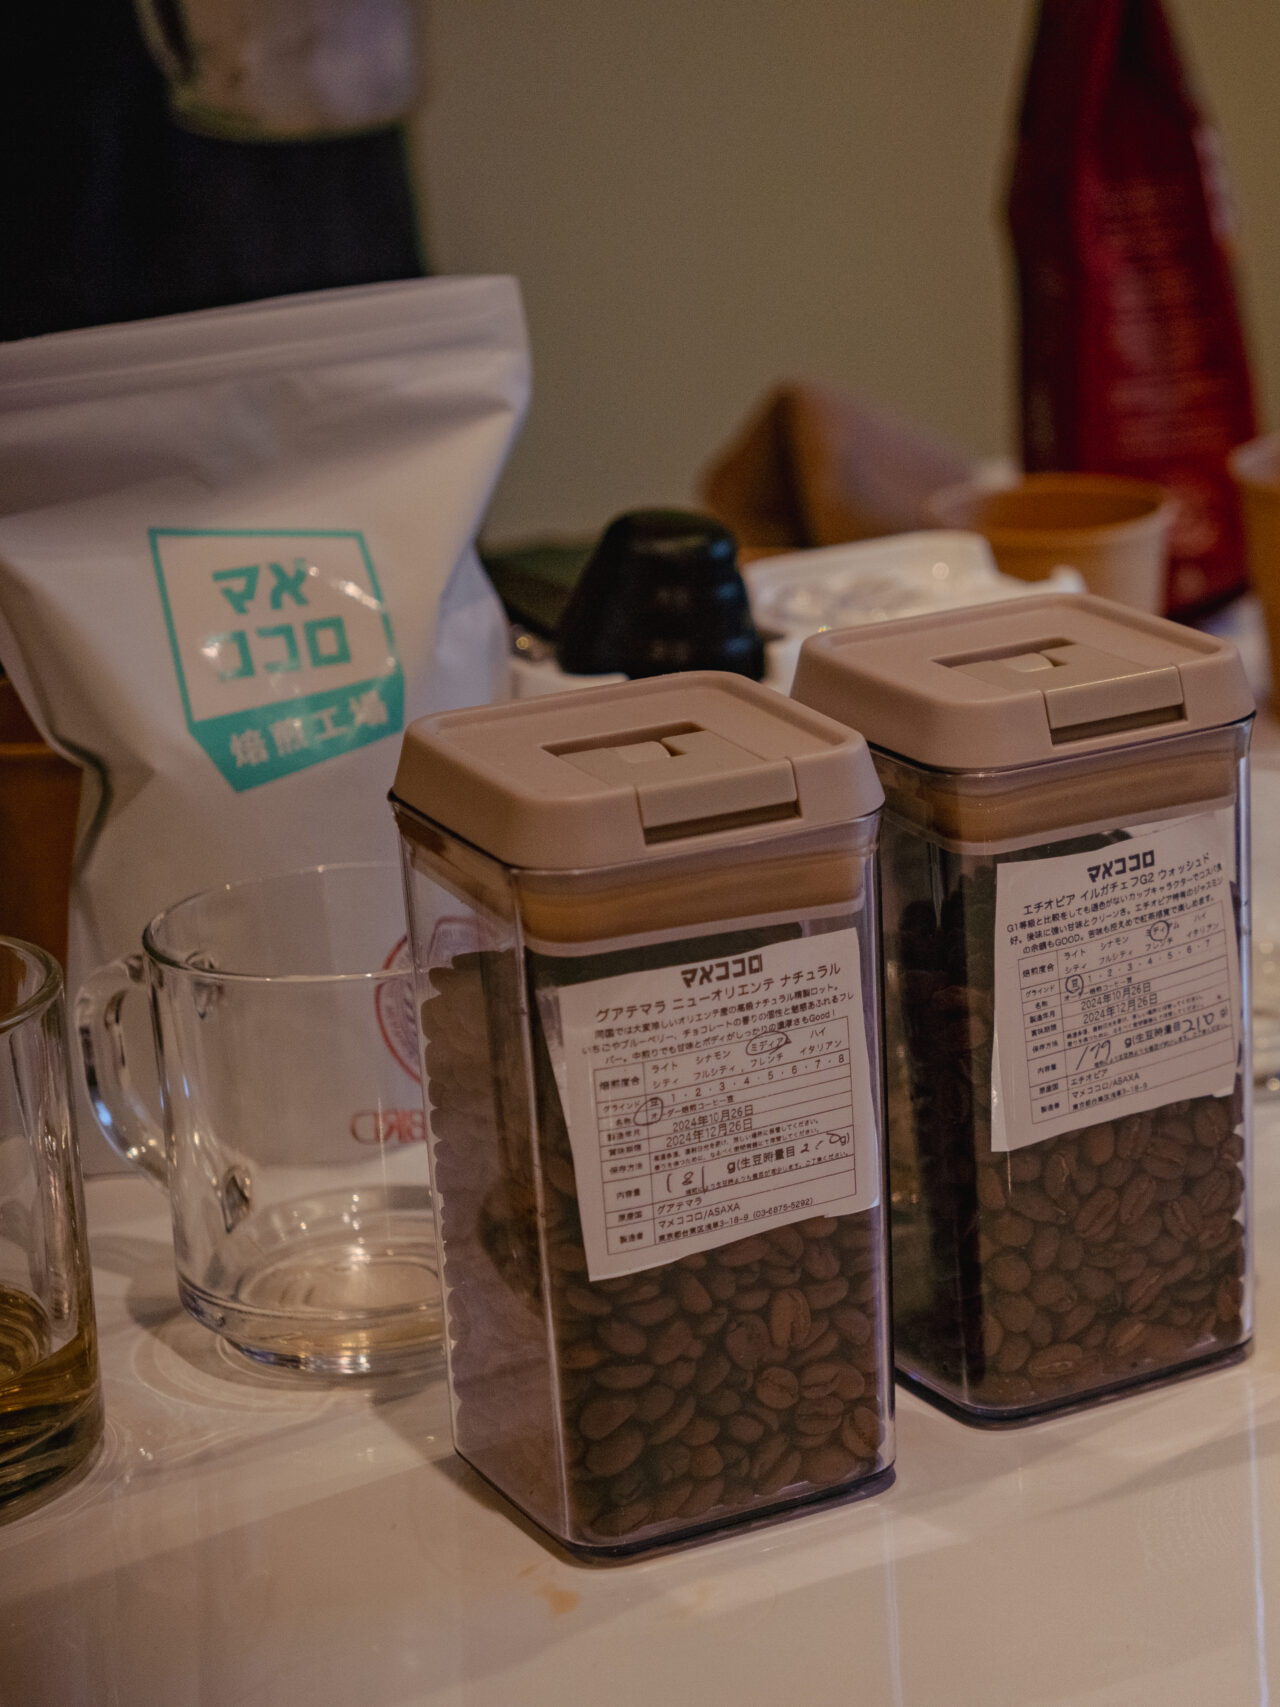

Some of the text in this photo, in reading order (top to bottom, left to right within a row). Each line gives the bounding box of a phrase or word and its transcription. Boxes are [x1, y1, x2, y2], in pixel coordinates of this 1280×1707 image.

[212, 557, 309, 614] マメ
[1087, 849, 1154, 883] マメココロ
[1023, 894, 1074, 916] エチオピア
[1081, 872, 1153, 901] イルガチェフG2
[681, 953, 763, 989] マメココロ
[595, 962, 840, 1024] グアテマラ ニューオリエンテ ナチュラル
[1081, 982, 1150, 1010] 2024年10月26日
[1083, 993, 1157, 1024] 2024年12月26日
[651, 1060, 678, 1074] ライト
[695, 1048, 731, 1064] シナモン
[810, 1027, 826, 1039] ハイ
[693, 1063, 735, 1081] フルシティ
[750, 1052, 784, 1067] フレンチ
[799, 1039, 842, 1056] イタリアン
[665, 1117, 752, 1148] 2024年12月26日
[672, 1104, 753, 1133] 2024年10月26日
[656, 1196, 702, 1215] グアテマラ
[658, 1202, 740, 1230] マメココロ/ASAXA
